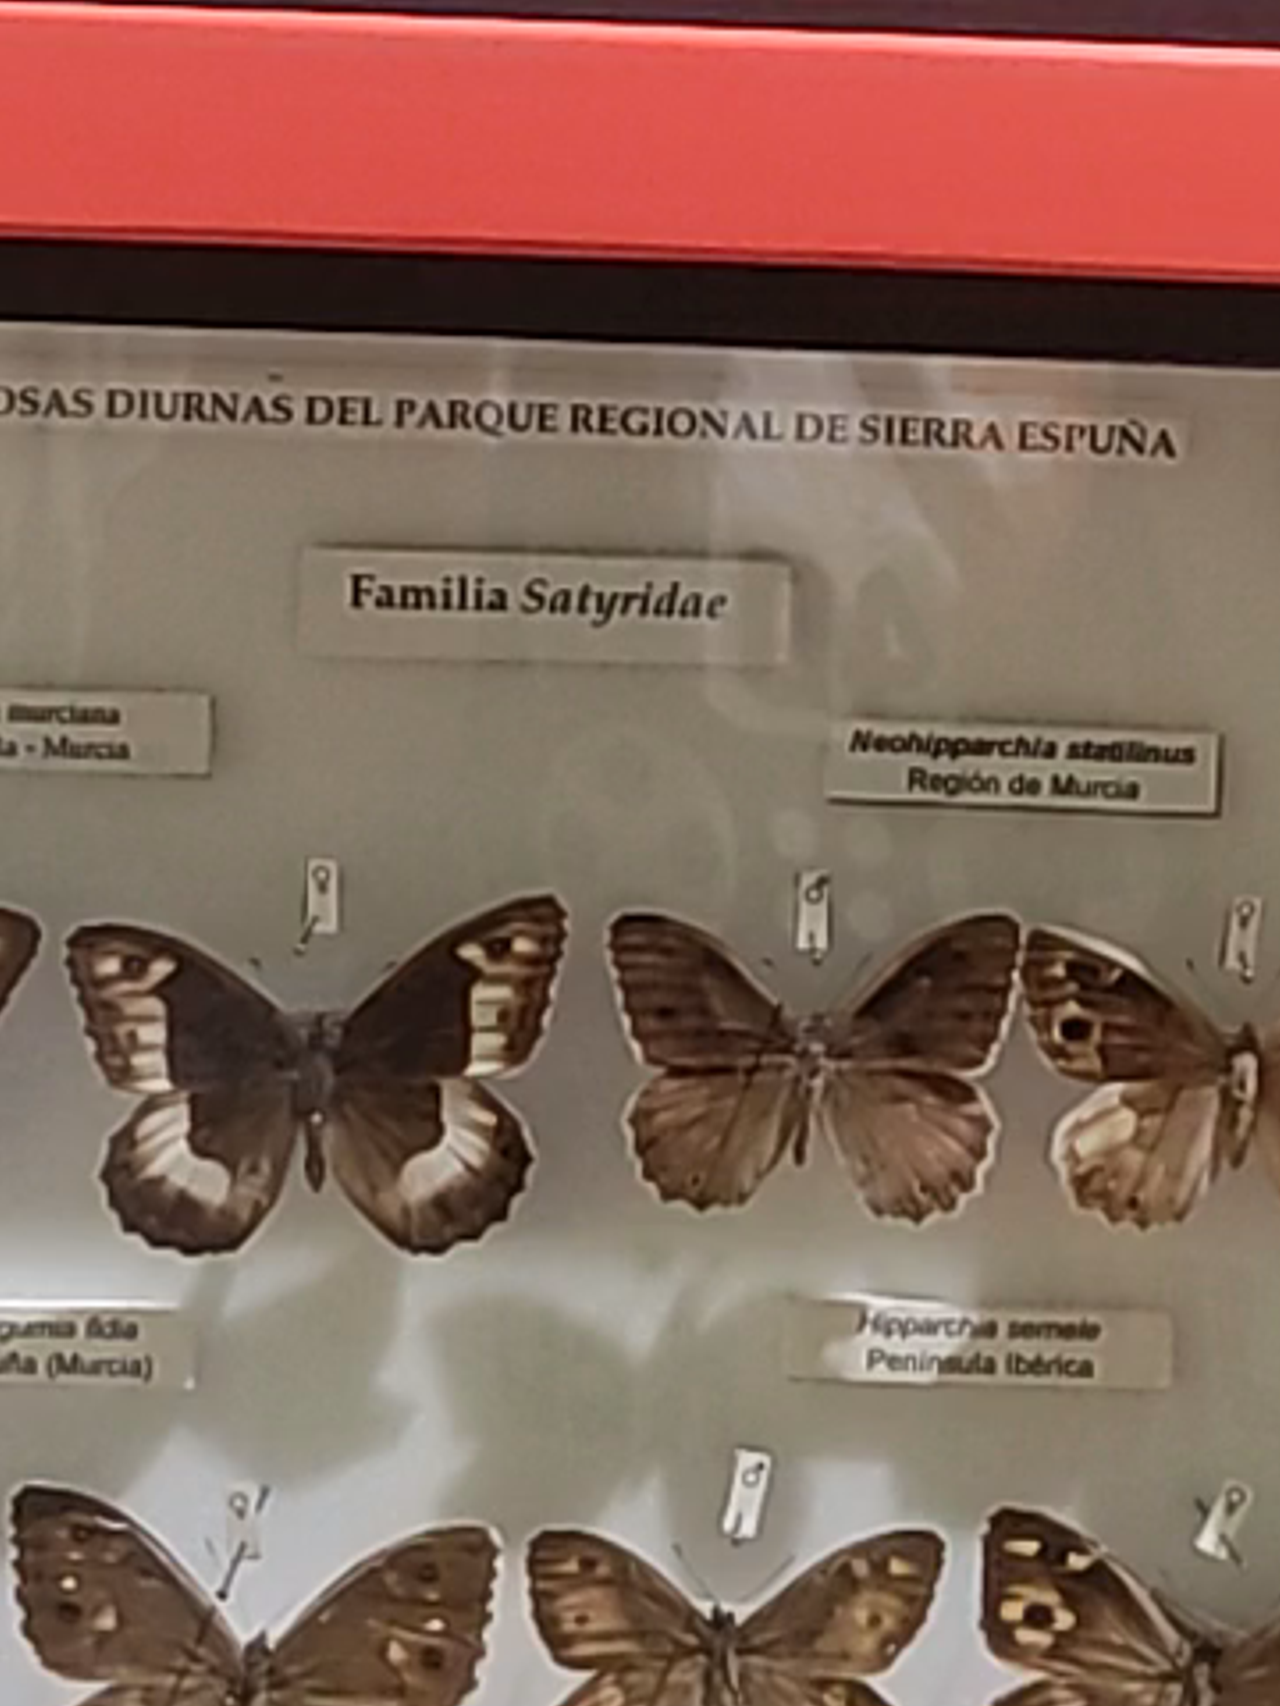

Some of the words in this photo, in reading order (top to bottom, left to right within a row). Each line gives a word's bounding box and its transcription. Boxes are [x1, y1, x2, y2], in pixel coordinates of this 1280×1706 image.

[107, 388, 294, 426] DIURNAS
[306, 394, 382, 429] DEL
[394, 398, 559, 438] PARQUE
[570, 403, 783, 443] REGIONAL
[795, 411, 848, 444] DE
[859, 413, 1006, 454] SIERRA
[1018, 419, 1178, 460] ESPUÑA
[350, 574, 508, 614] Familia
[520, 578, 728, 628] Satyridae
[43, 735, 130, 761] Murcia
[908, 767, 1001, 798] Región
[1008, 771, 1041, 796] de
[1050, 773, 1141, 801] Murcia
[46, 1352, 153, 1381] (Murcia)
[1006, 1350, 1094, 1379] Ibérica
